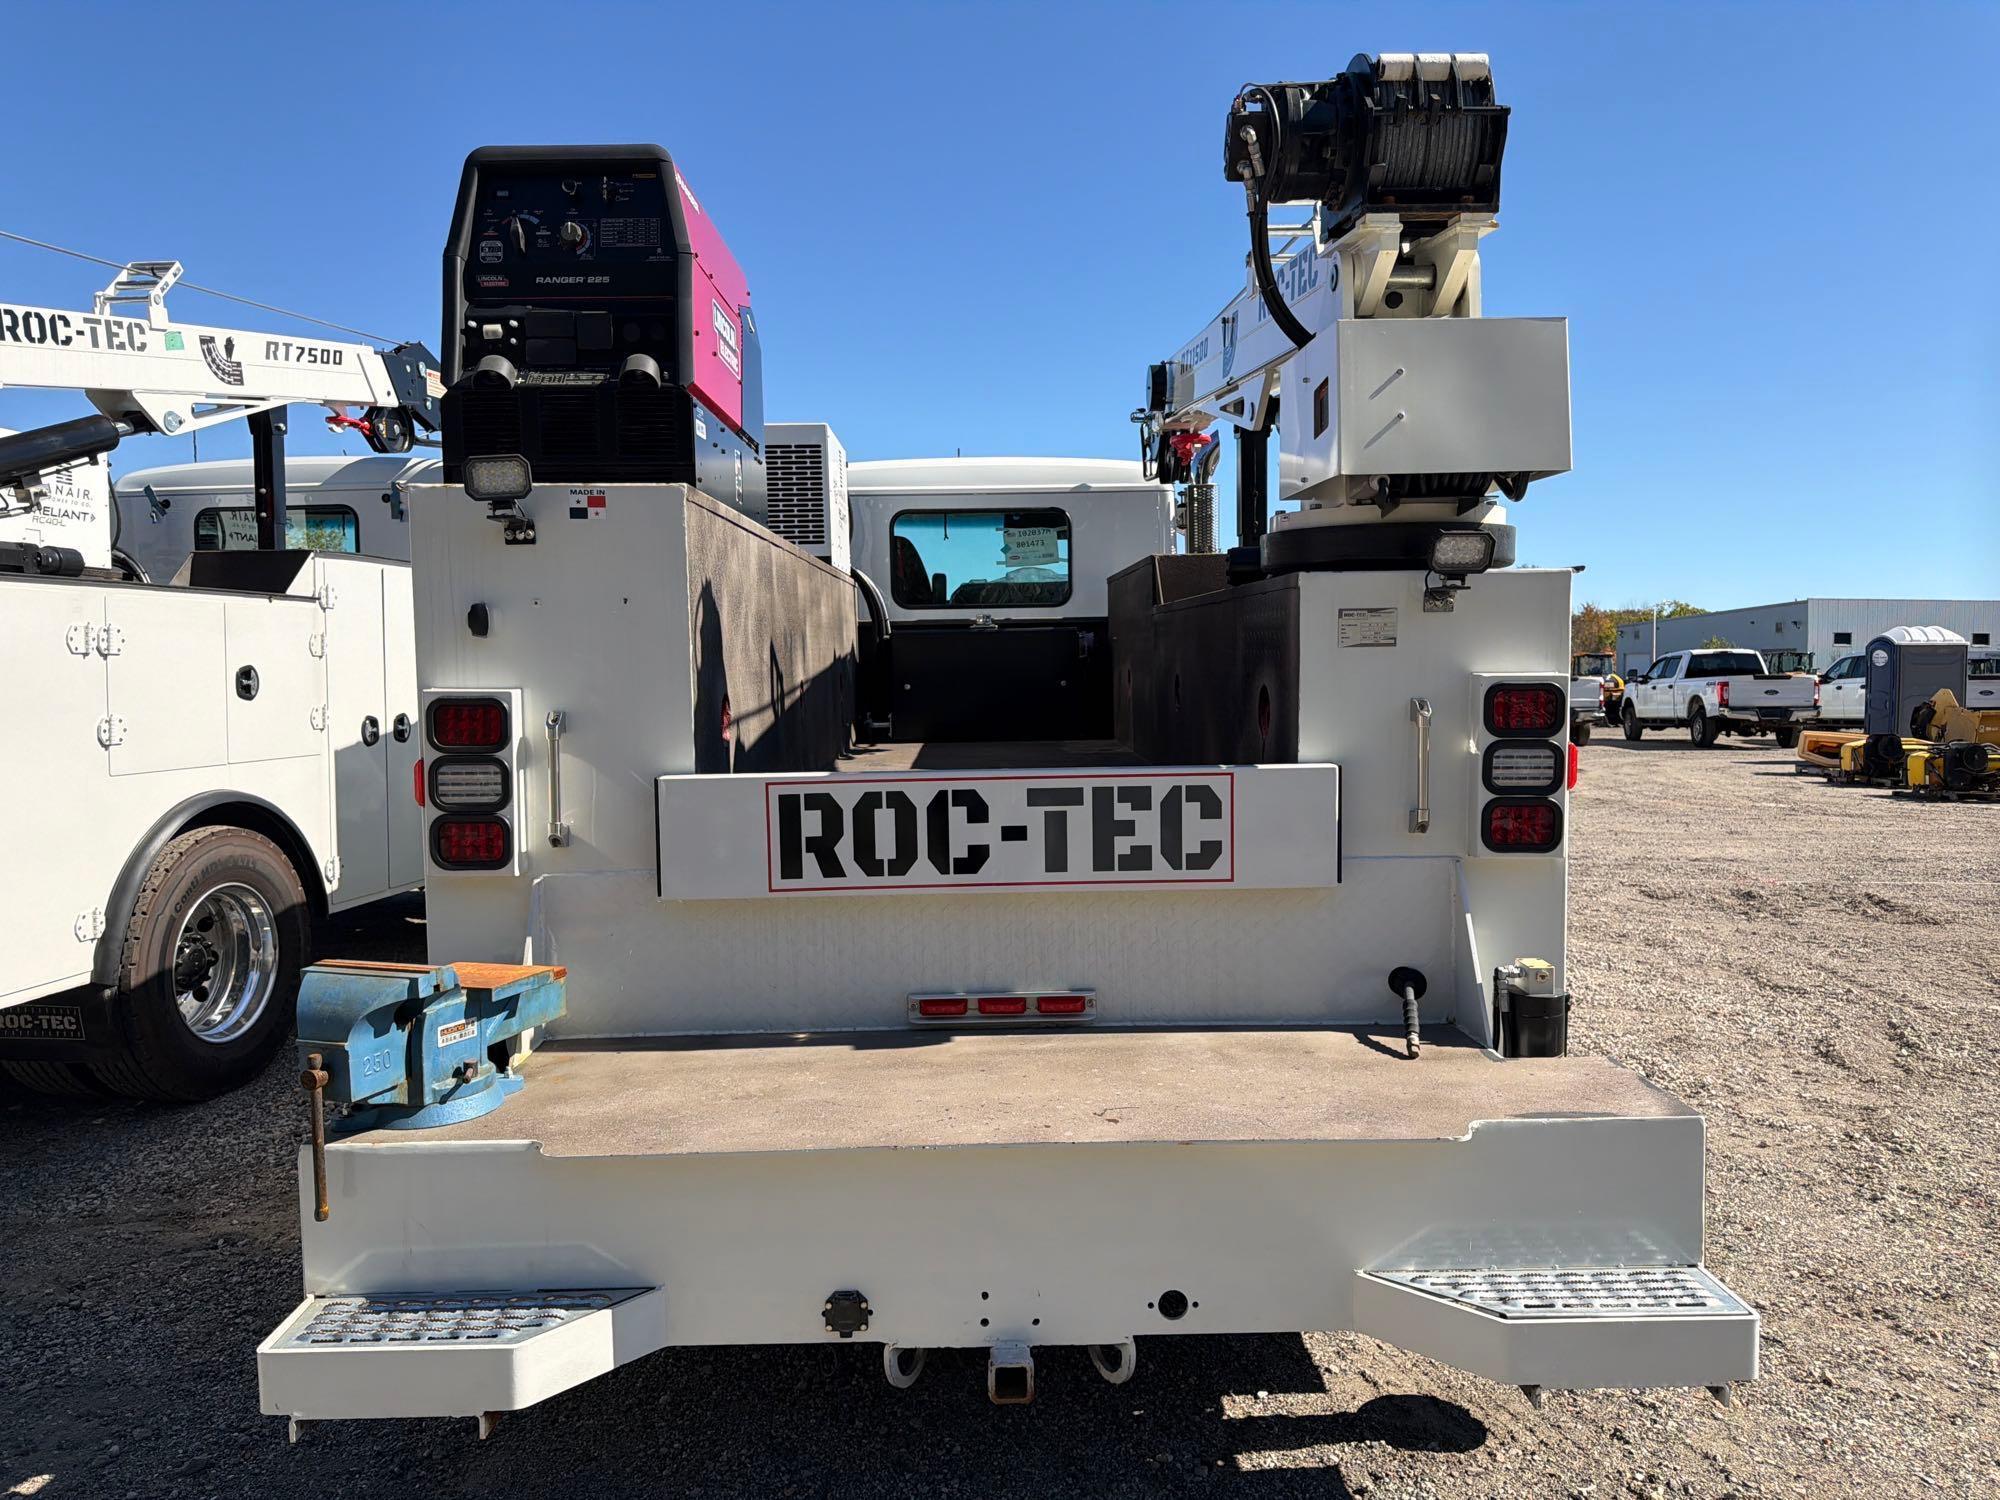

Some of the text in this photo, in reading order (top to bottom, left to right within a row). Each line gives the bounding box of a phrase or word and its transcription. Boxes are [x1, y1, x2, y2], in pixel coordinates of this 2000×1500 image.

[535, 275, 610, 284] RANGER 225
[0, 308, 148, 352] ROC-TEC
[265, 340, 343, 366] RT7500
[47, 483, 91, 500] NAIR
[40, 505, 90, 522] ELIANT
[778, 784, 1223, 880] ROC-TEC
[363, 1049, 391, 1077] 250
